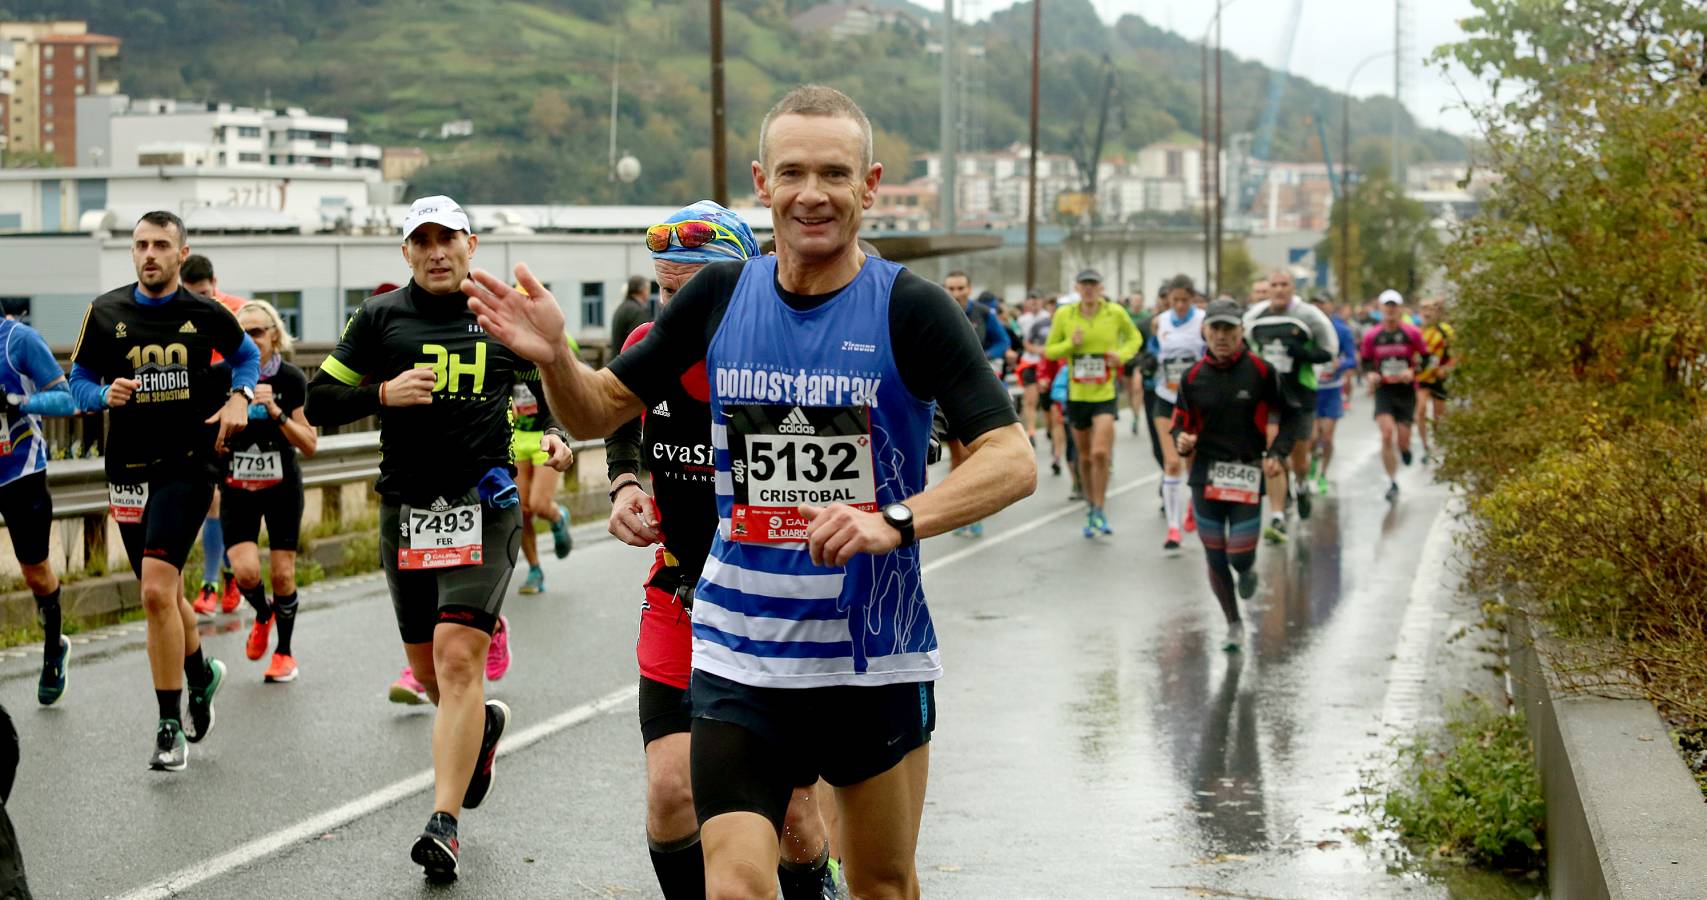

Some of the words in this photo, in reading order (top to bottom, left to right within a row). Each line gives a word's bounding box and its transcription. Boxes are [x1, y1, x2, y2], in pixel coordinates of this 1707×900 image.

[126, 342, 188, 369] 100
[135, 371, 189, 393] BEHOBIA
[136, 392, 150, 404] SAN
[652, 409, 671, 417] adidas
[778, 424, 816, 434] adidas
[235, 456, 274, 471] 7791
[750, 441, 860, 483] 5132
[1216, 465, 1257, 483] 8646
[760, 488, 856, 503] CRISTOBAL
[412, 509, 475, 535] 7493
[768, 529, 779, 537] EL
[436, 537, 453, 546] FER
